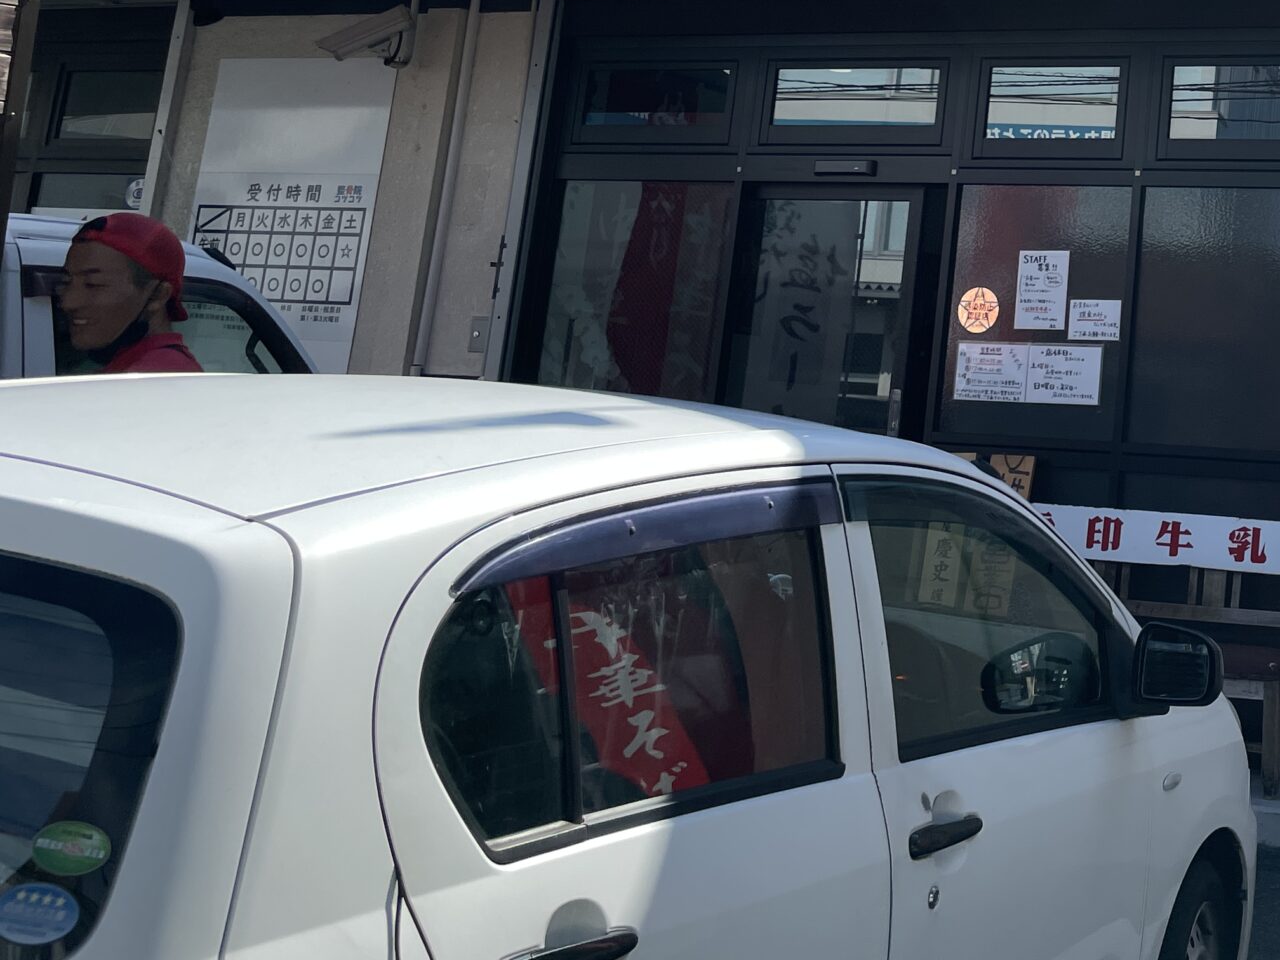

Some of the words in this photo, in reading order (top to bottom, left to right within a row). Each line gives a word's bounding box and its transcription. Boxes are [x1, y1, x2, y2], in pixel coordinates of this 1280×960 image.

[246, 183, 322, 203] 受付時間
[234, 212, 246, 228] 月
[255, 212, 268, 228] 火
[277, 213, 291, 228] 水
[299, 213, 313, 229] 木
[321, 213, 336, 230] 金
[343, 215, 357, 229] 土
[1023, 255, 1047, 264] STAFF
[1041, 512, 1267, 565] 印牛乳
